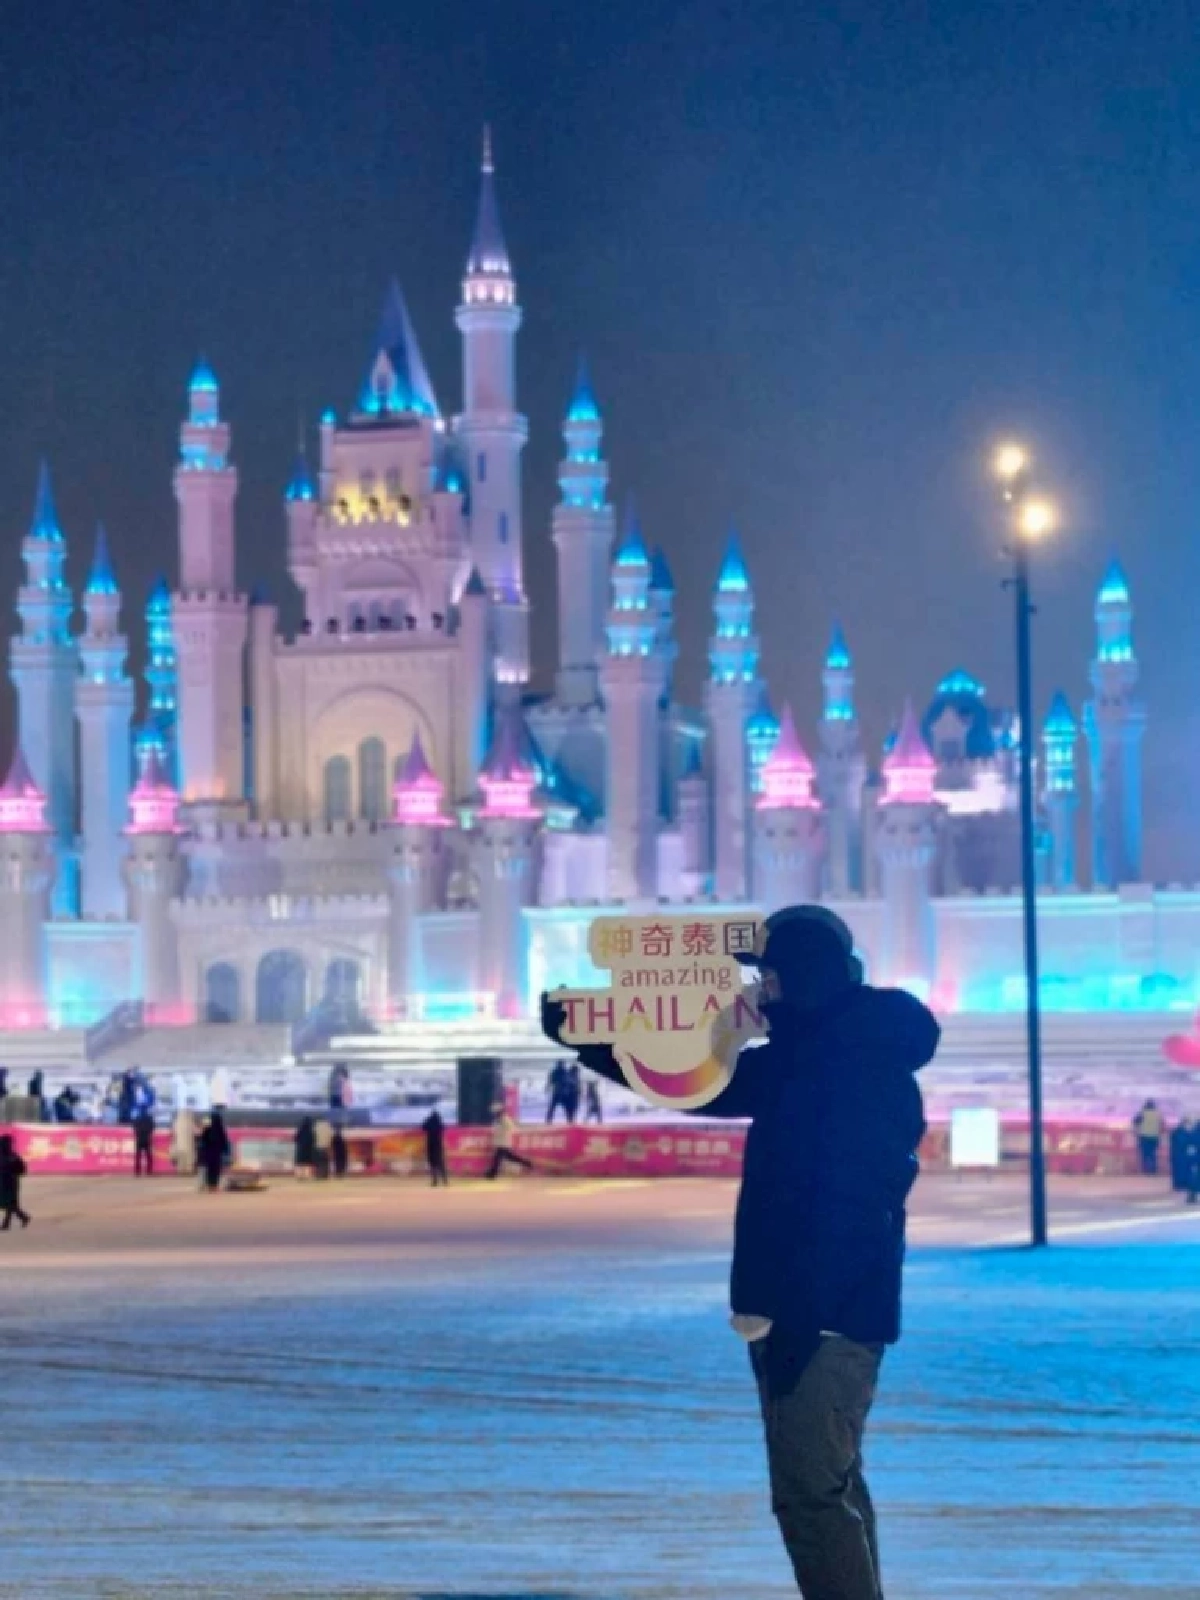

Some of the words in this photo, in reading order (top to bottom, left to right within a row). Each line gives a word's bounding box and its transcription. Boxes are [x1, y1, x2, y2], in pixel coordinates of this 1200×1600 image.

[599, 921, 757, 957] 神奇泰国
[621, 962, 731, 989] amazing
[560, 994, 764, 1034] THAILAN
